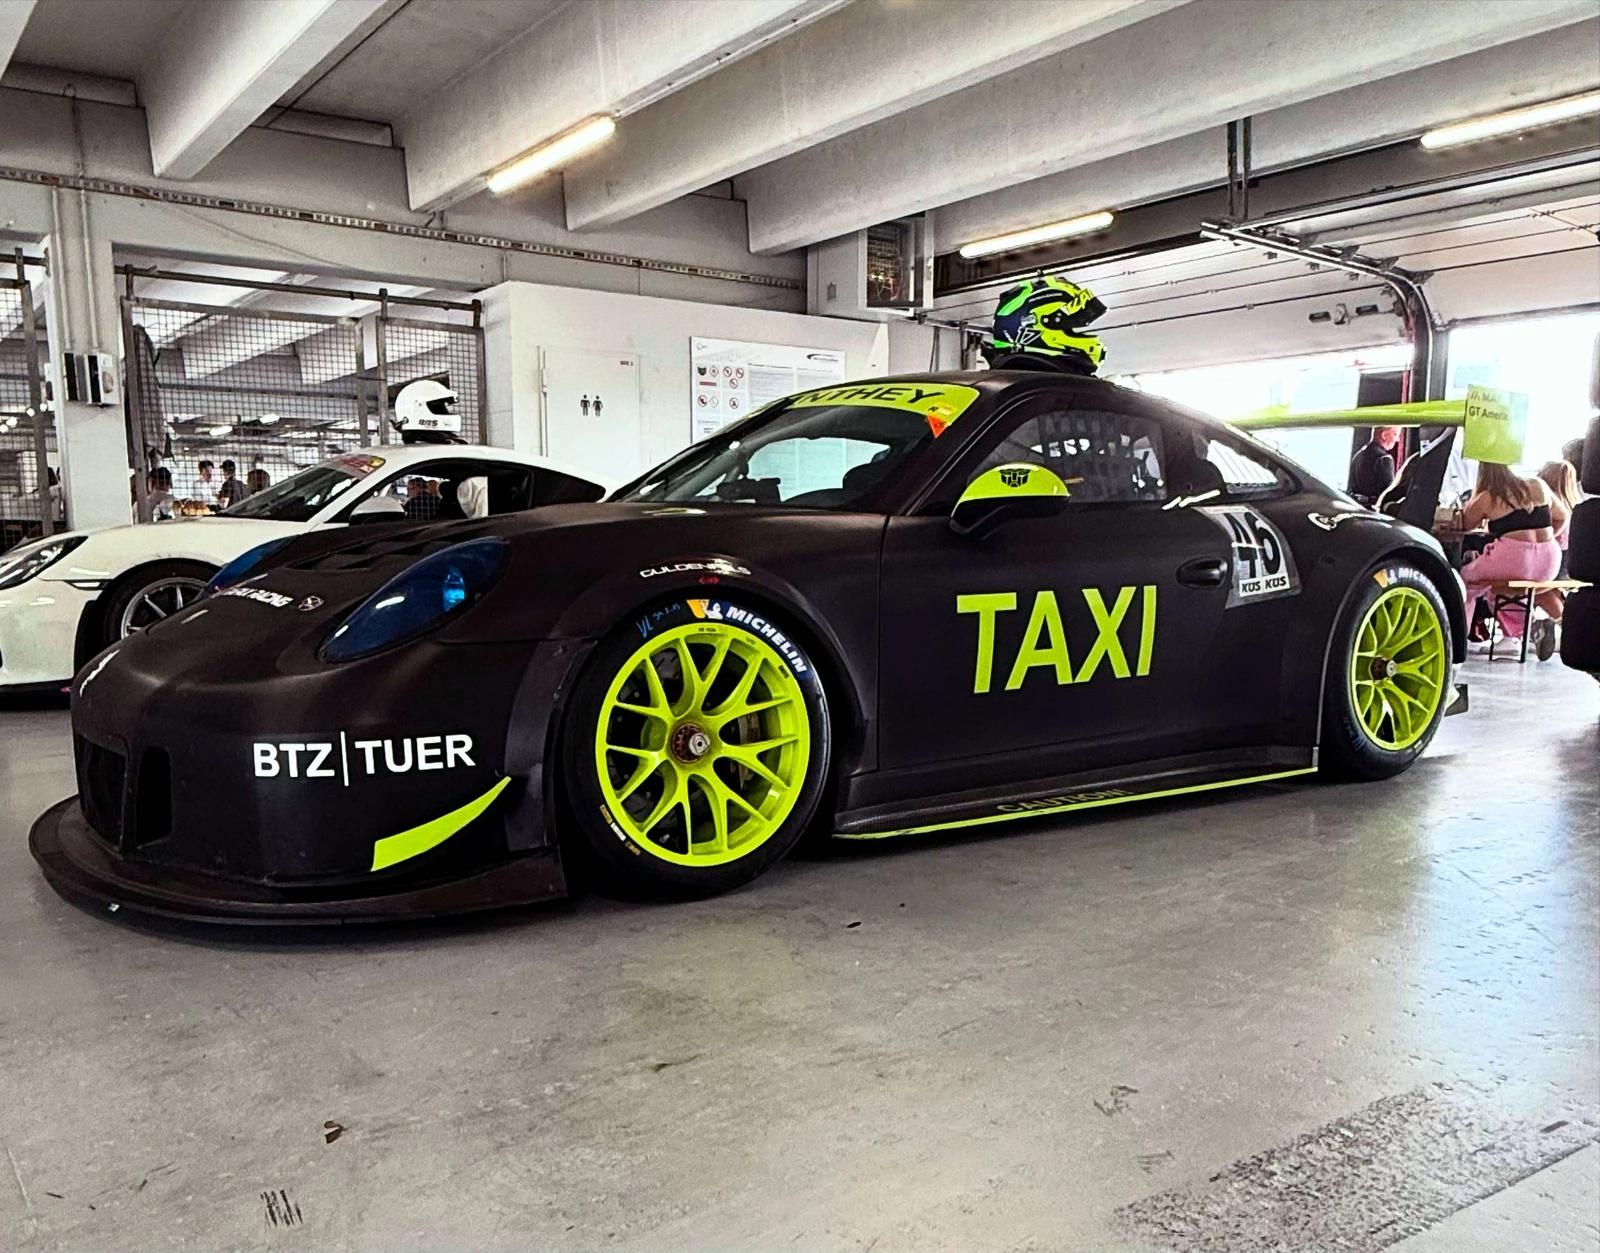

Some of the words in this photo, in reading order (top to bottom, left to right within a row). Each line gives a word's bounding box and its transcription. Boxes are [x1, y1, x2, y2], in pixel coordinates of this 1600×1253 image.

[795, 387, 946, 404] NTHEY
[1469, 405, 1481, 417] GT
[1223, 511, 1281, 579] 46
[725, 604, 809, 674] MICHELIN
[956, 584, 1158, 694] TAXI
